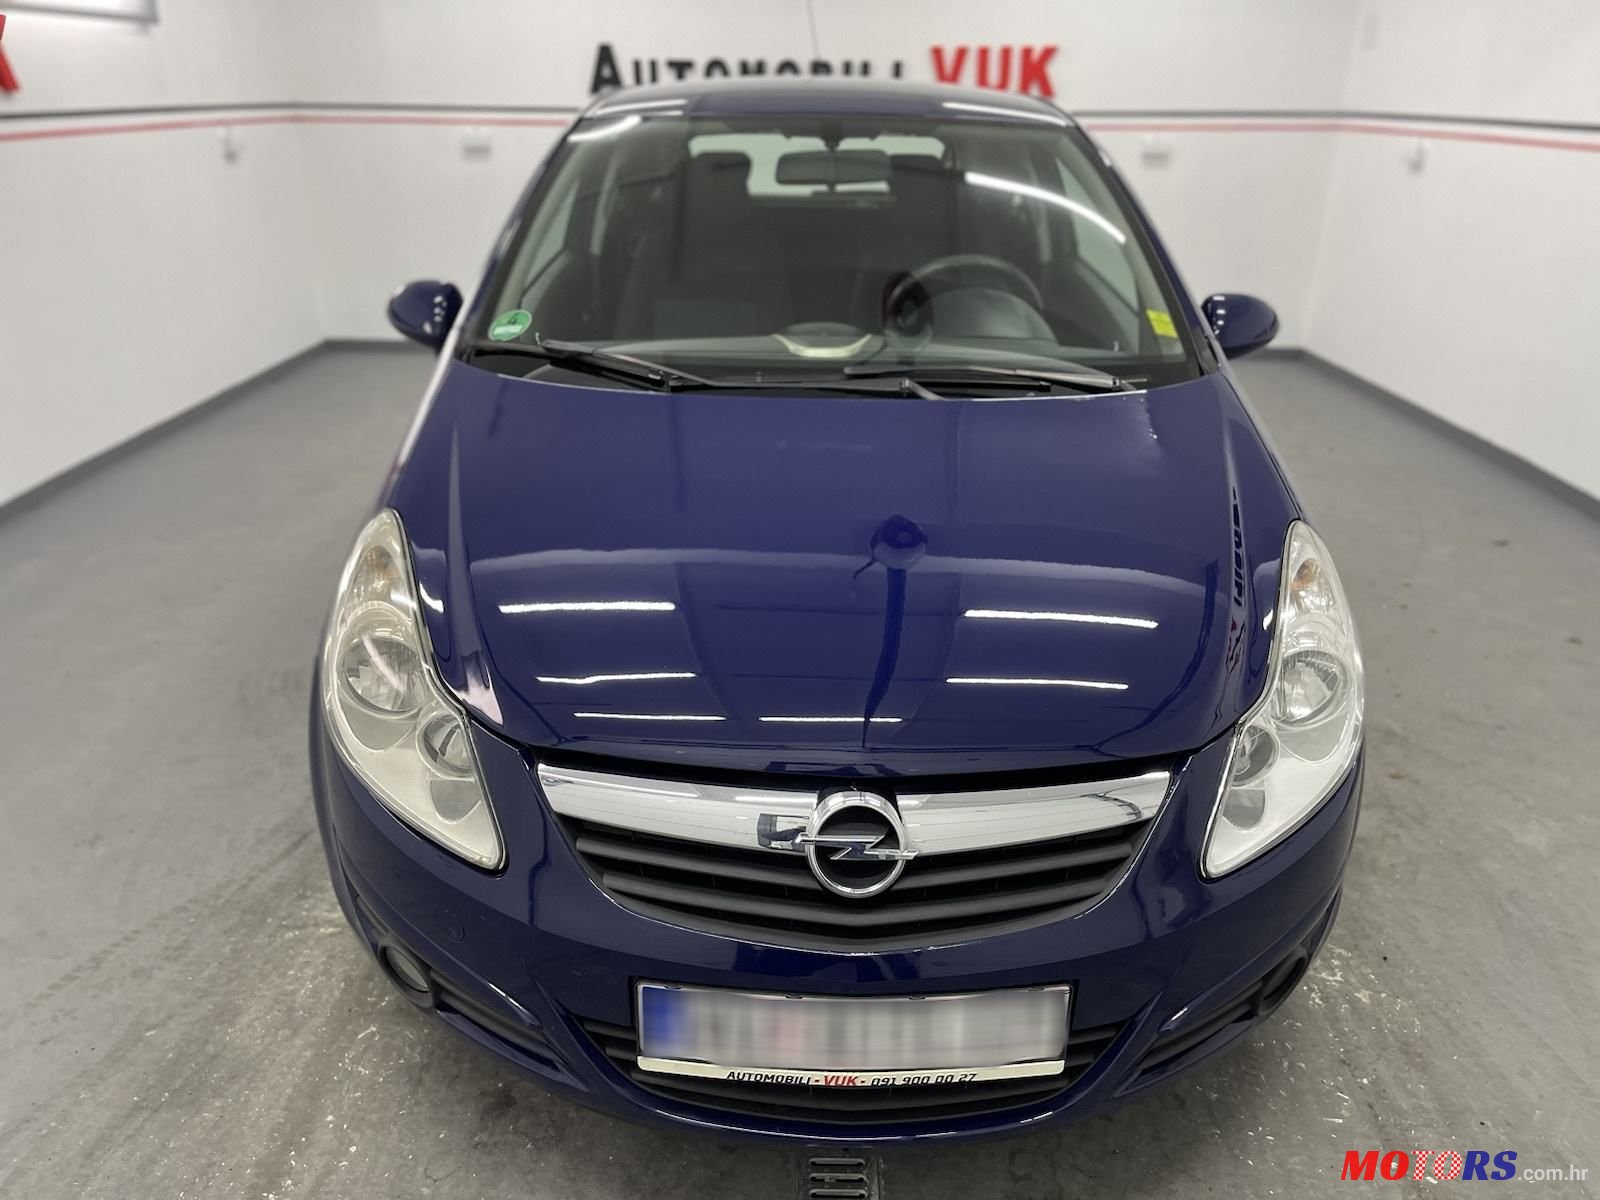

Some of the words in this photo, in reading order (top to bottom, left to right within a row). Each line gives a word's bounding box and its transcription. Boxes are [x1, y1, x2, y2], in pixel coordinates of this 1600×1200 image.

[929, 44, 1058, 98] VUK
[727, 1071, 811, 1085] AUTOMOBILI
[823, 1075, 858, 1087] VUK
[871, 1077, 897, 1086] 091
[902, 1076, 931, 1086] 900
[935, 1074, 955, 1084] 00
[959, 1073, 977, 1083] 27
